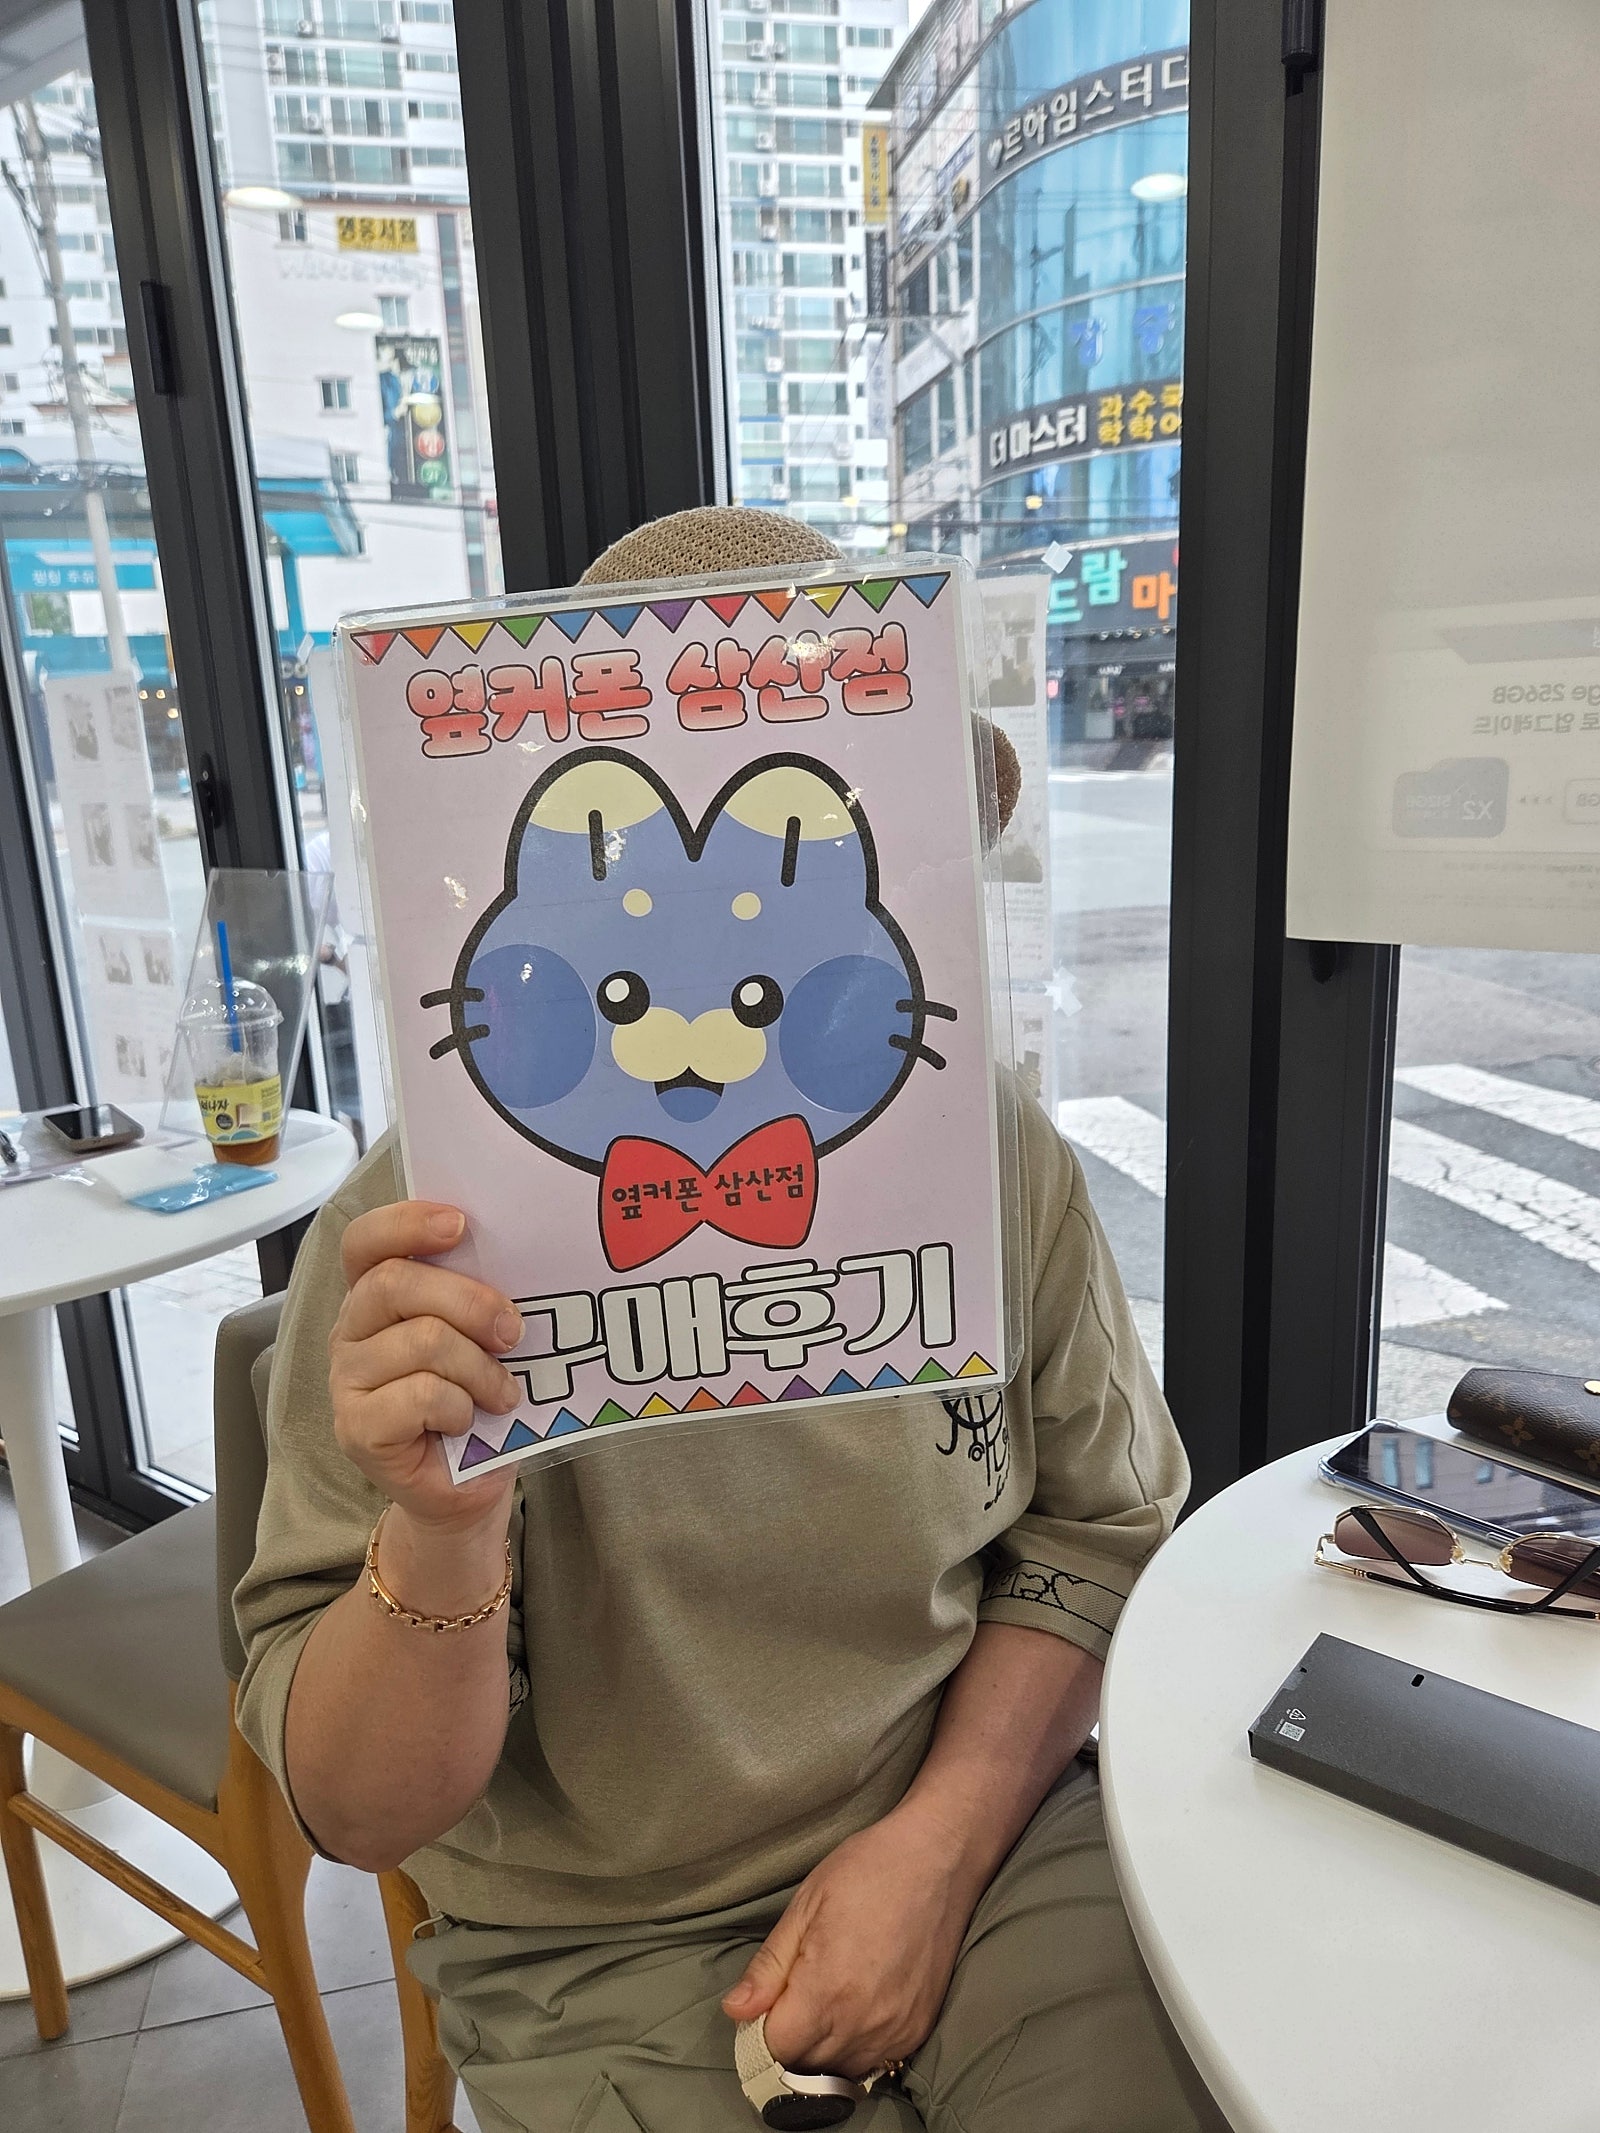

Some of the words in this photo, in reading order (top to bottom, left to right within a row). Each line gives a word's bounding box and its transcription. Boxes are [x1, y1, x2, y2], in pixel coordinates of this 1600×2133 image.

[406, 648, 653, 760] 옆커폰
[666, 620, 914, 732] 삼산점
[611, 1176, 703, 1221] 옆커폰
[714, 1162, 804, 1208] 삼산점
[499, 1241, 958, 1406] 구매후기
